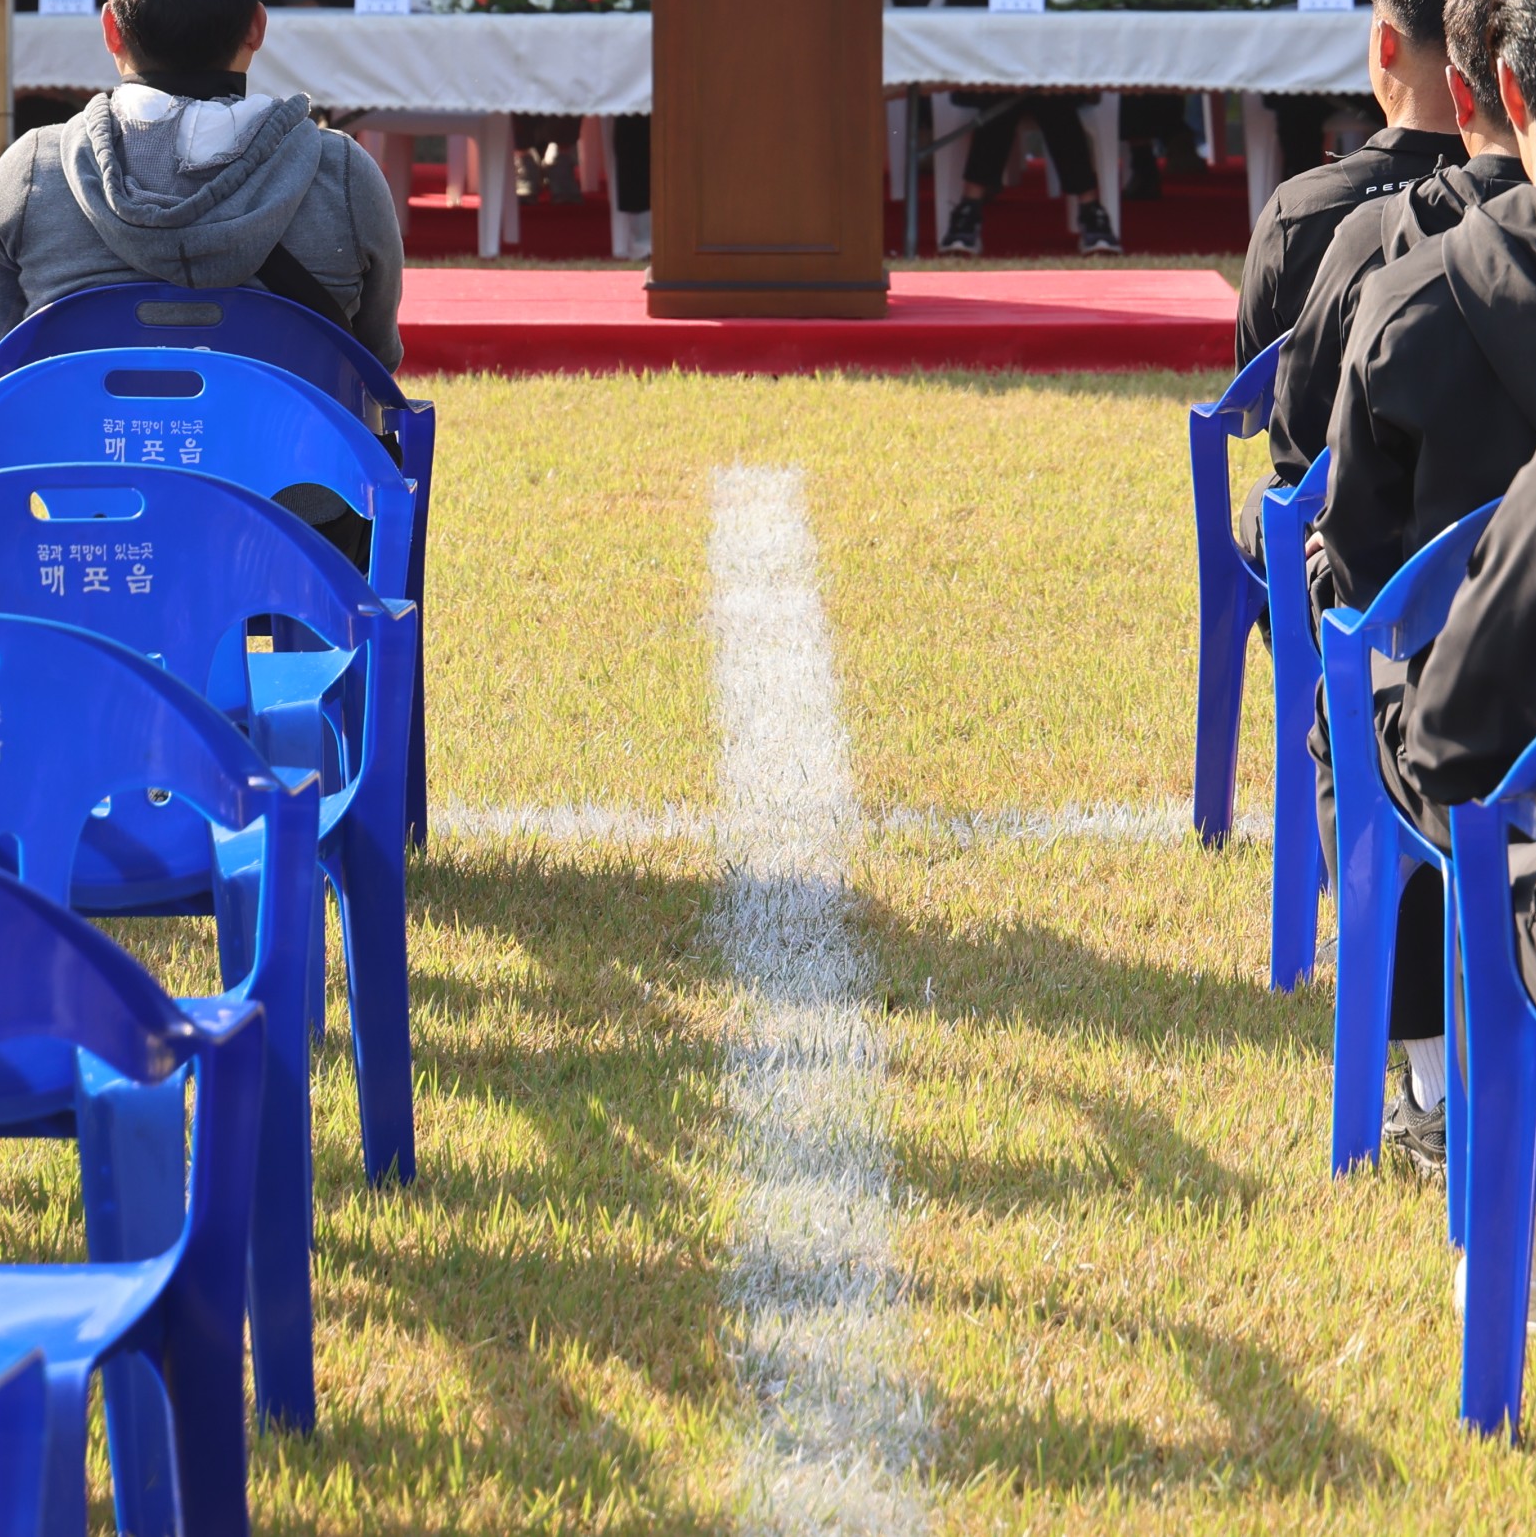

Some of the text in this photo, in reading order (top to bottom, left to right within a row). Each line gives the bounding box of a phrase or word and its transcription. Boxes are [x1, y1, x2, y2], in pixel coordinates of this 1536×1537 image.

[103, 419, 125, 434] 꿈과
[131, 420, 163, 435] 희망이
[37, 544, 62, 562] 꿈과
[69, 544, 107, 562] 희망이
